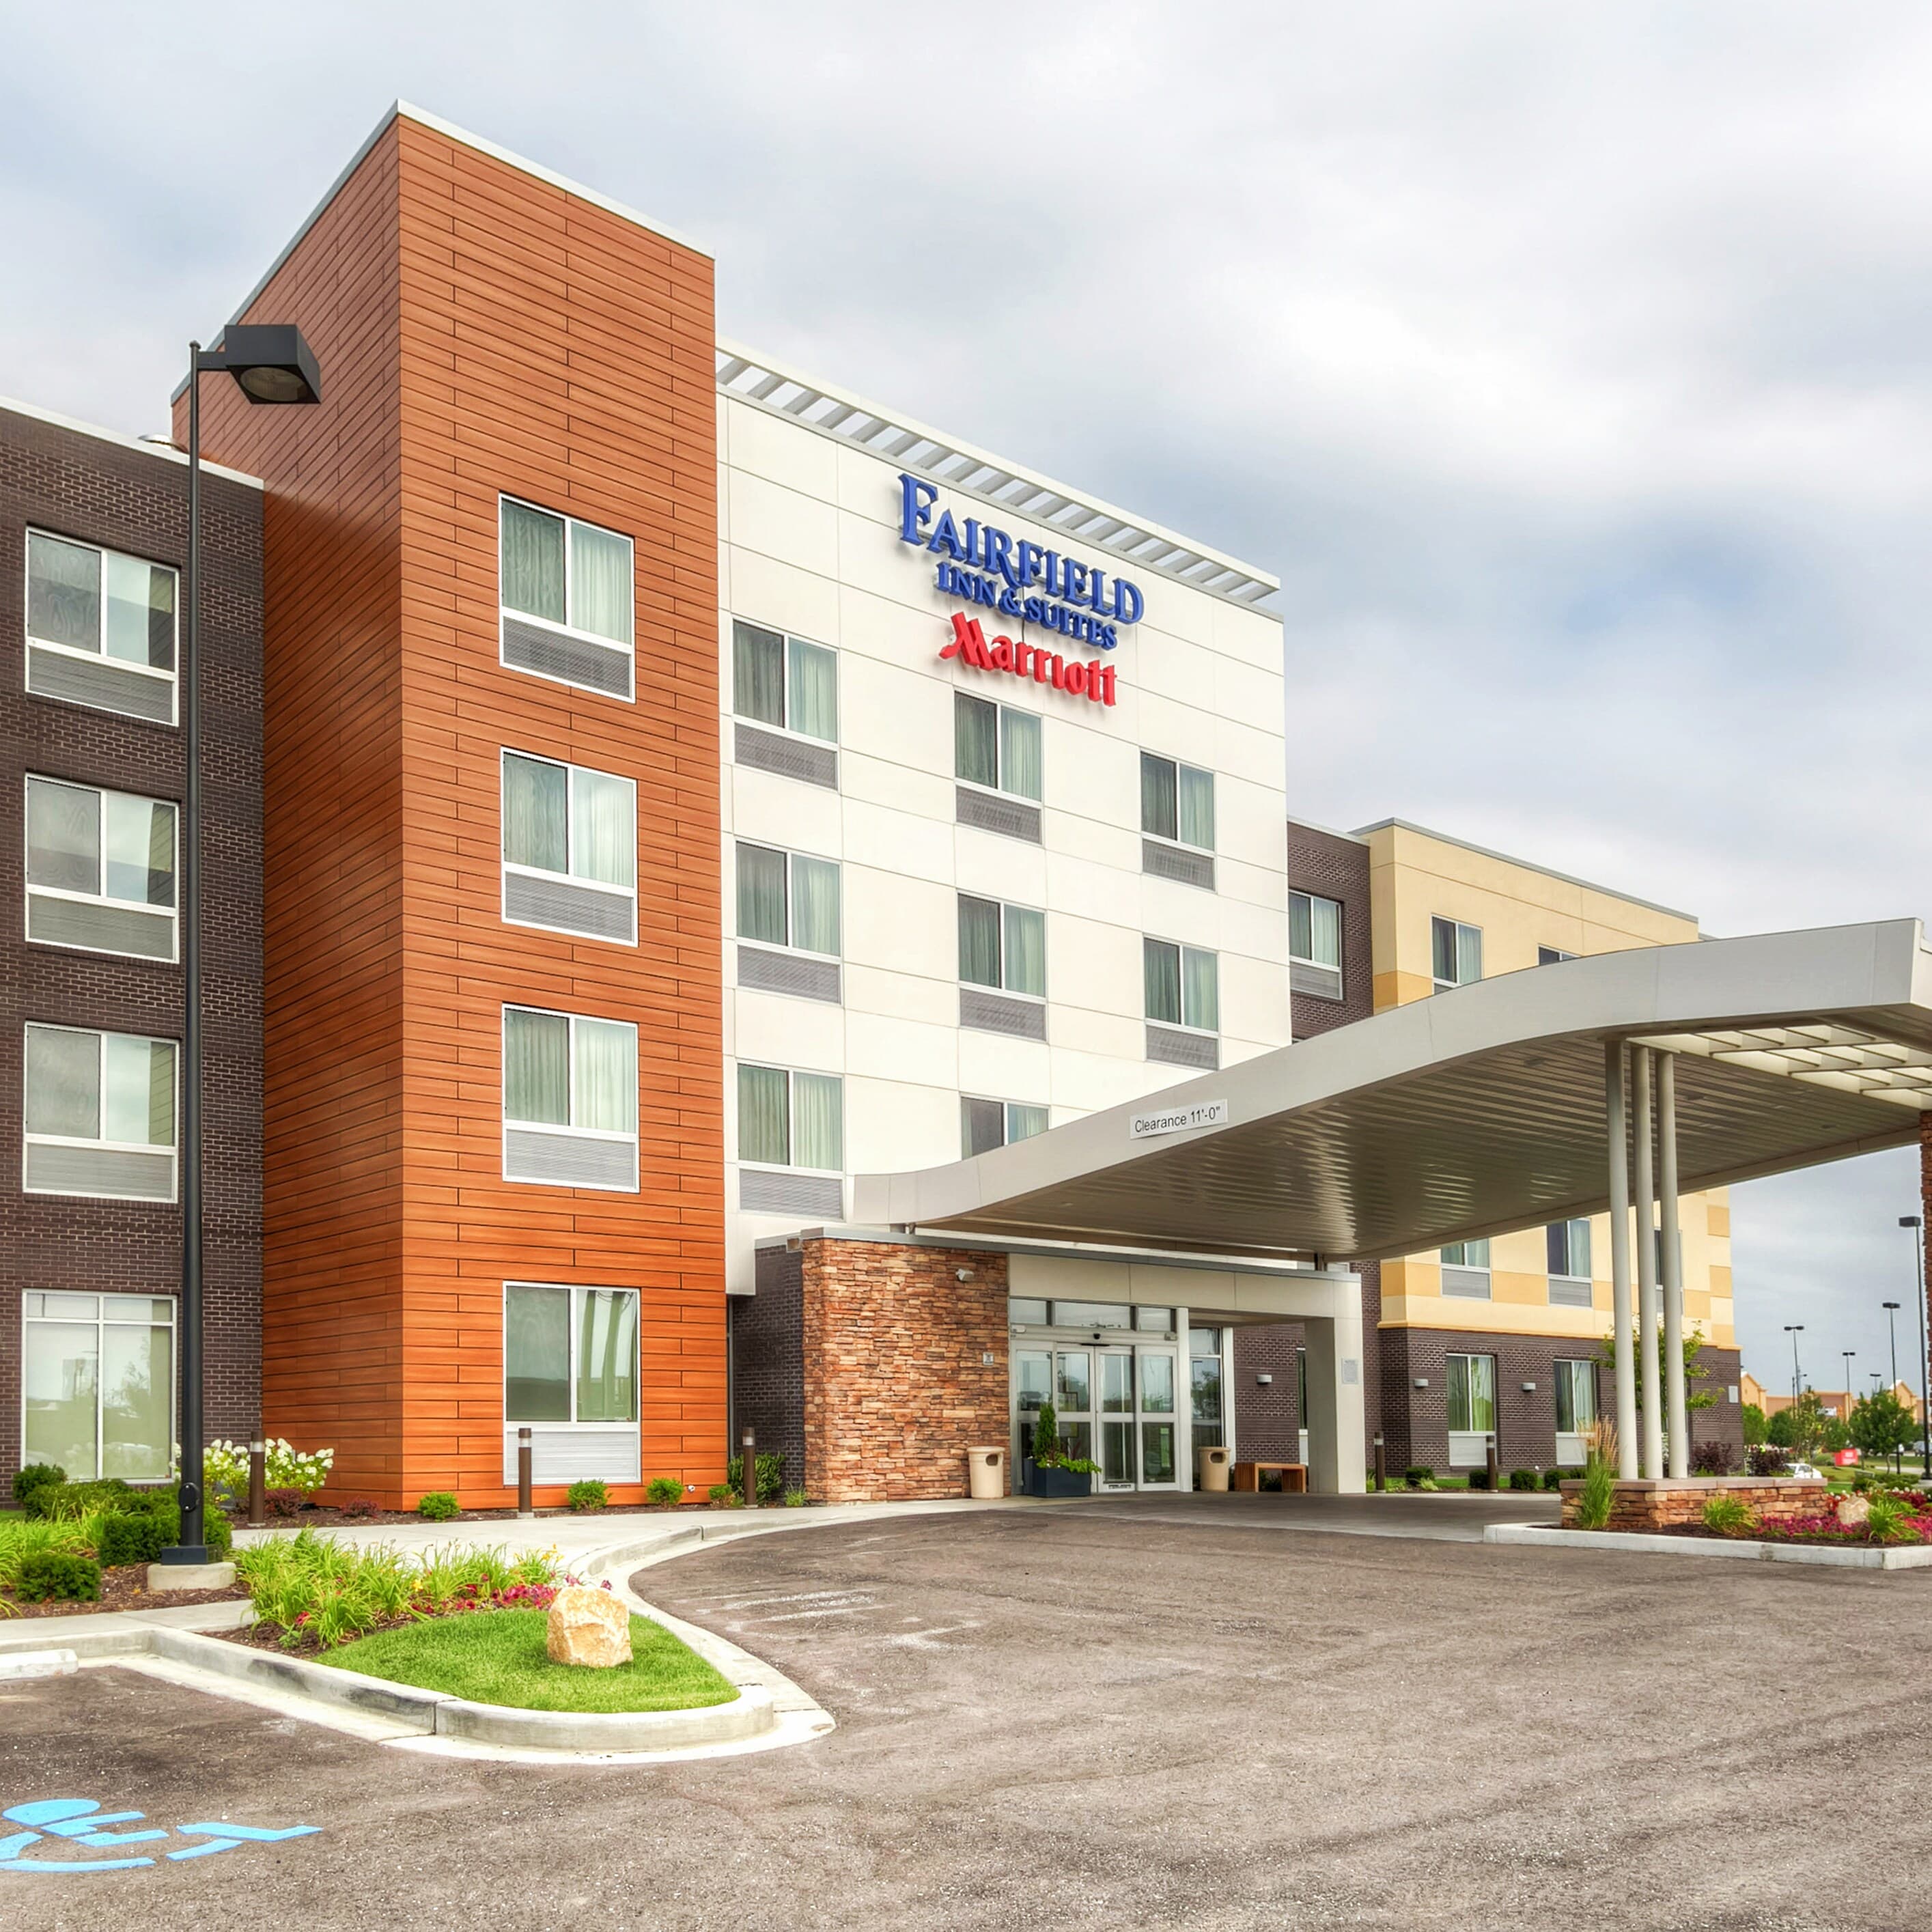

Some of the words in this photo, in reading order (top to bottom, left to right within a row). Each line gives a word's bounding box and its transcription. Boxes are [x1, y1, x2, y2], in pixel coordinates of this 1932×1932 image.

[898, 473, 1145, 625] FAIRFIELD
[938, 611, 1117, 707] Marriott
[1134, 1115, 1187, 1133] Clearance
